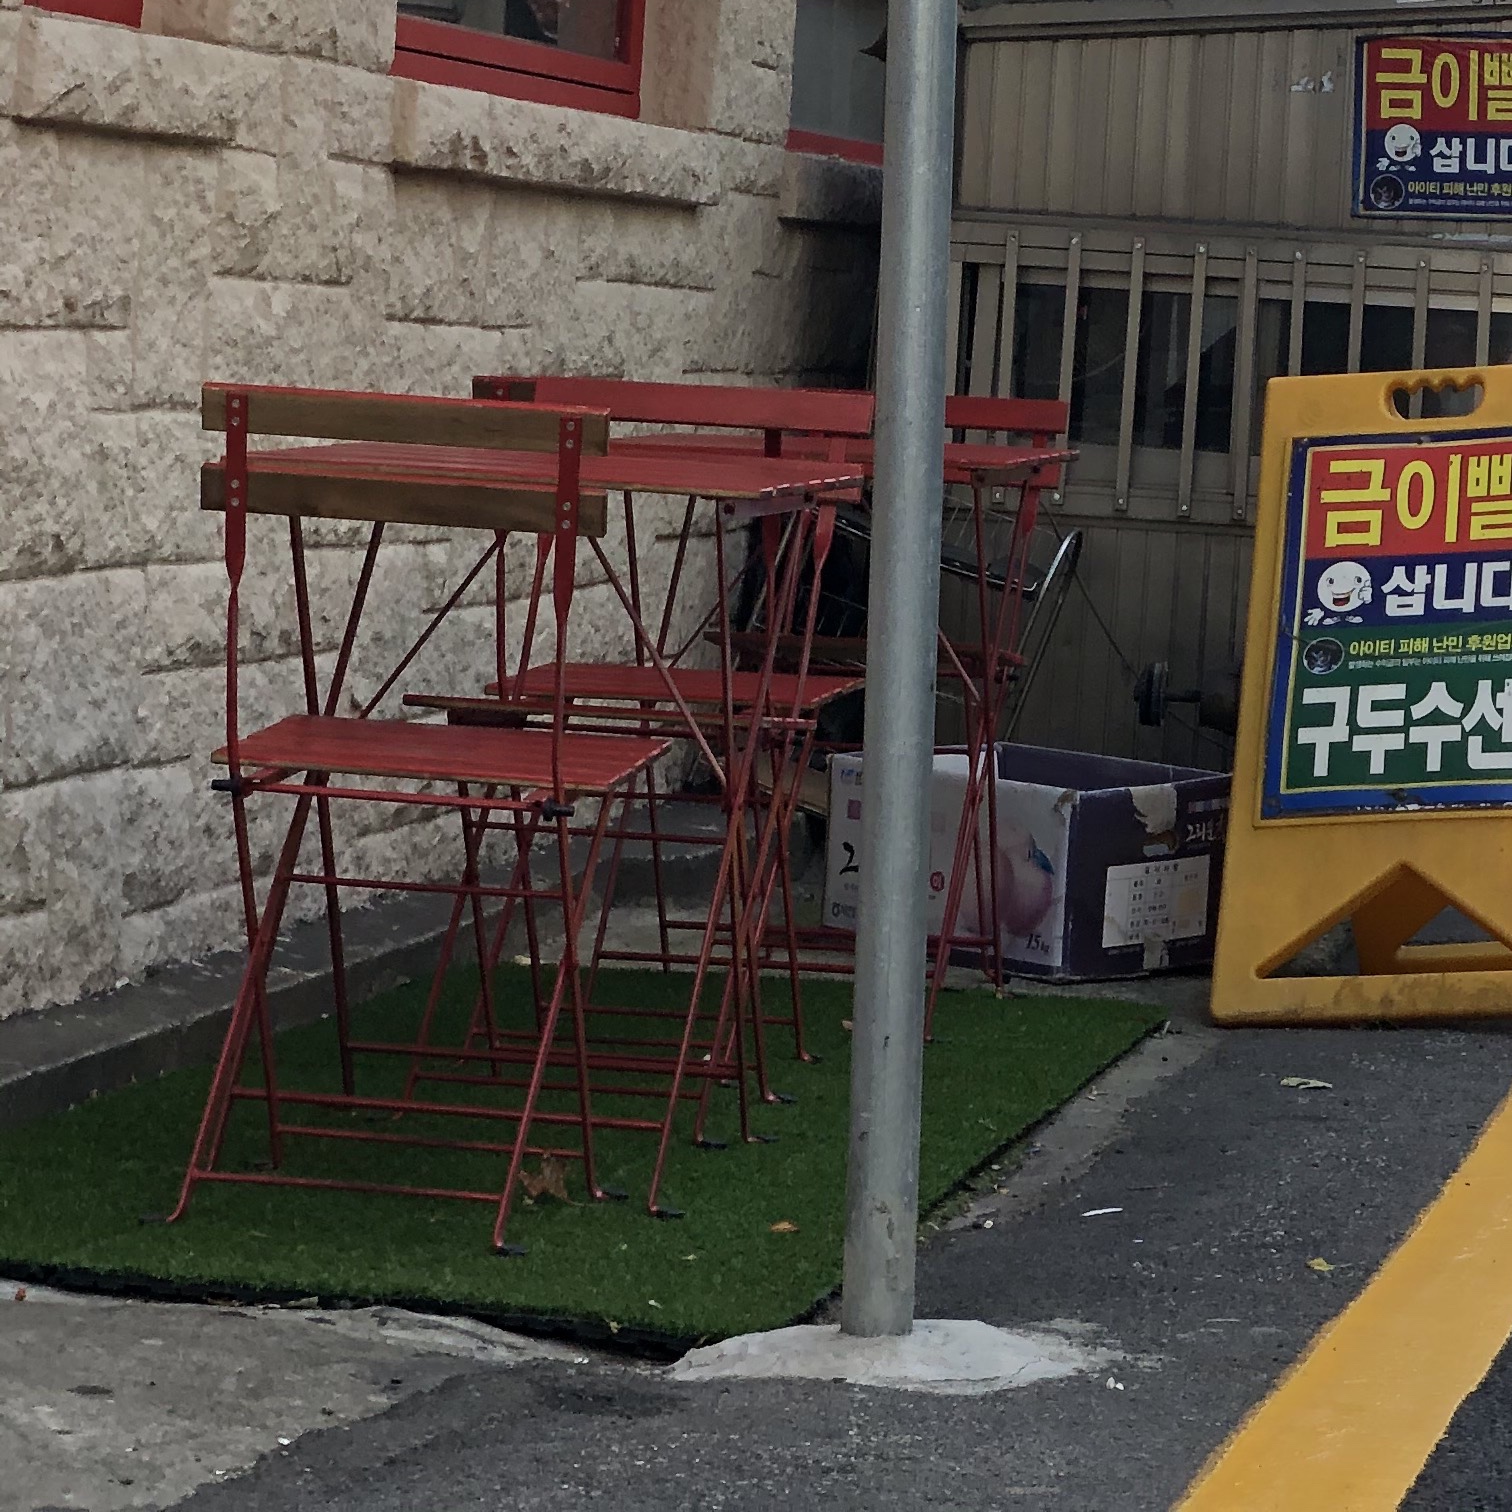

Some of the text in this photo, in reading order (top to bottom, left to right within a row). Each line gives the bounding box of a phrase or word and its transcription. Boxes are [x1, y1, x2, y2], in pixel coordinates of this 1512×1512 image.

[1349, 638, 1395, 657] 아이티
[1398, 637, 1430, 656] 피해
[1432, 635, 1463, 654] 난민
